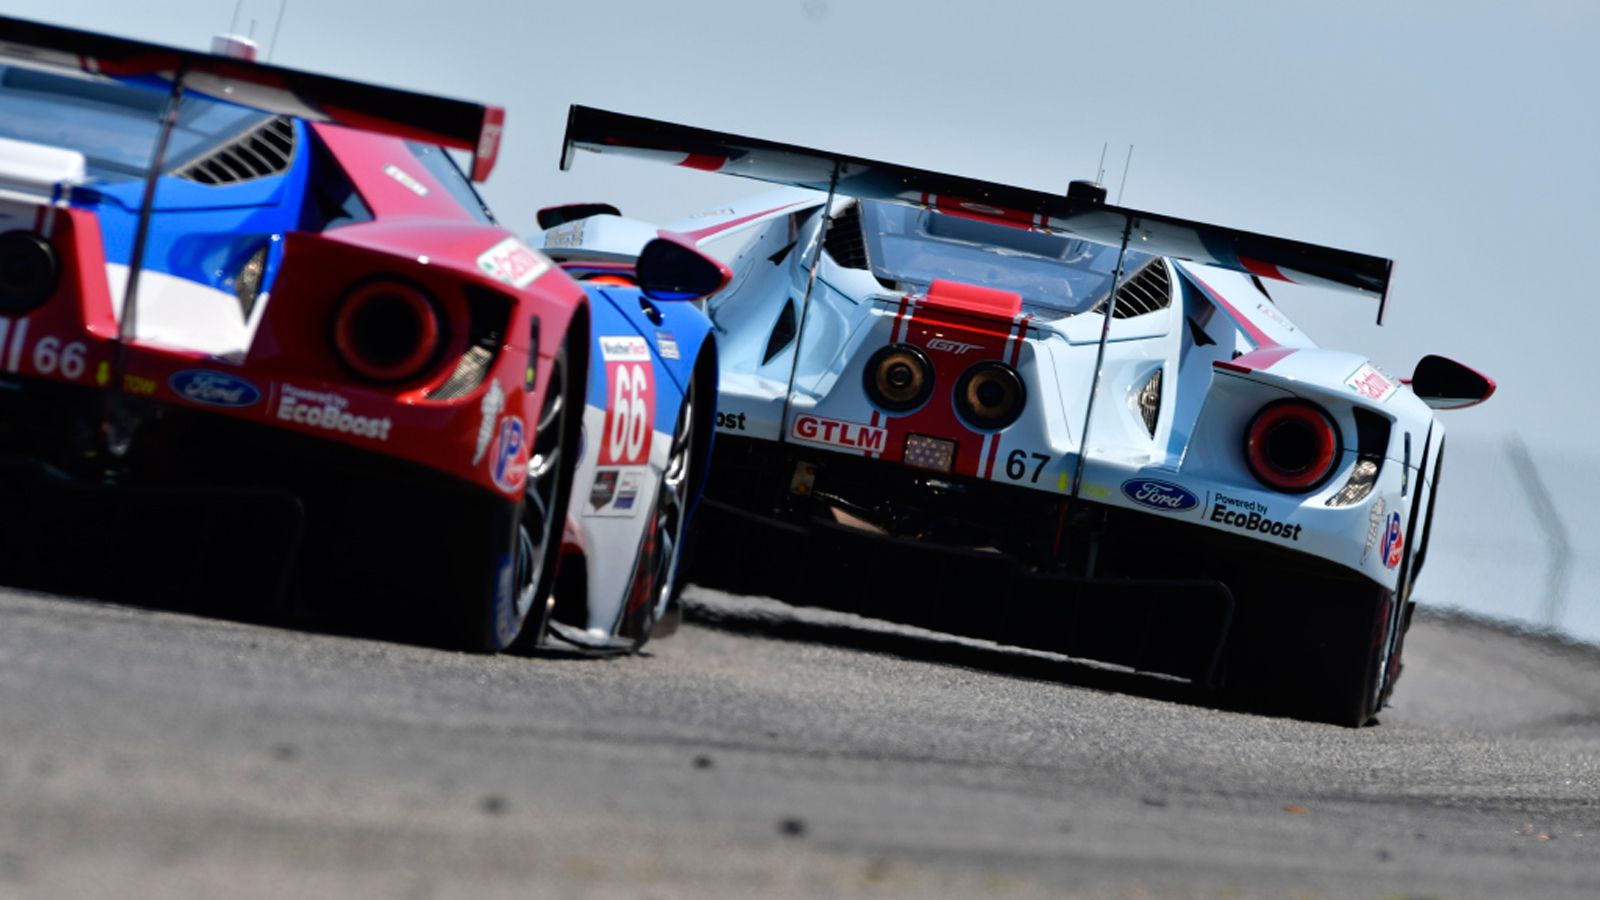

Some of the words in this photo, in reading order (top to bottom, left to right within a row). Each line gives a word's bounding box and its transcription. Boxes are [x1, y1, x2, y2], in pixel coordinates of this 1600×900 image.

[34, 336, 87, 379] 66
[184, 374, 247, 402] Ford
[277, 396, 392, 441] EcoBoost
[609, 364, 648, 463] 66
[796, 416, 884, 450] GTLM
[1005, 449, 1052, 483] 67
[1135, 481, 1186, 509] Ford
[1215, 493, 1256, 511] Powered
[1256, 501, 1268, 515] by
[1210, 503, 1302, 541] EcoBoost
